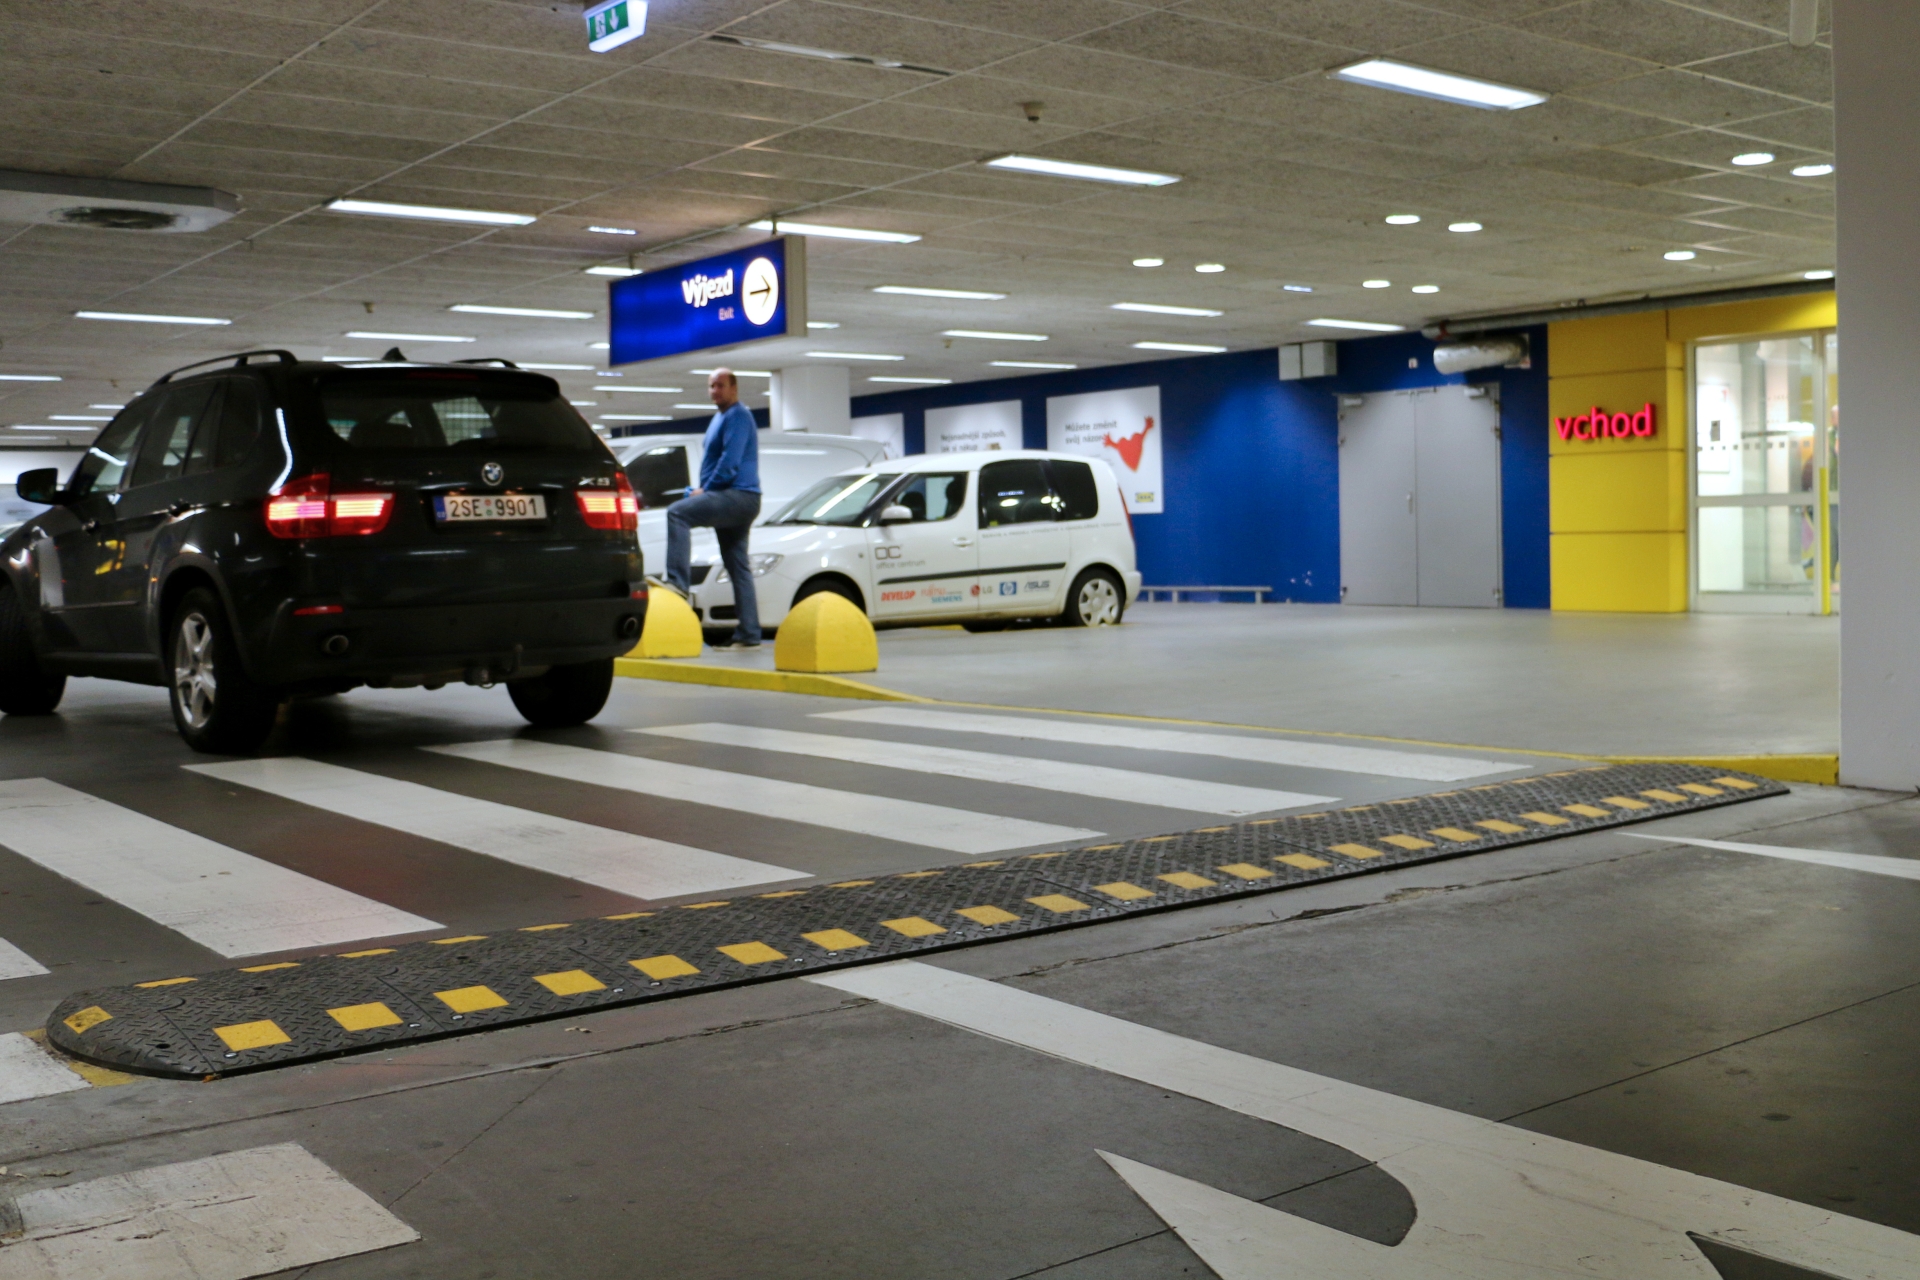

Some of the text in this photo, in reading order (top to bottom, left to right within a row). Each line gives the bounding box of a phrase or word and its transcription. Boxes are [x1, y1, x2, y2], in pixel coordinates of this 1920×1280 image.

[682, 268, 733, 308] Výjezd
[719, 307, 734, 321] Exit
[1554, 402, 1654, 441] vchod
[449, 497, 538, 518] 2SE 9901
[876, 559, 926, 570] office centrum
[982, 586, 993, 594] LG
[1024, 580, 1050, 590] ASUS
[881, 590, 916, 602] DEVELOP
[931, 595, 963, 604] SIEMENS
